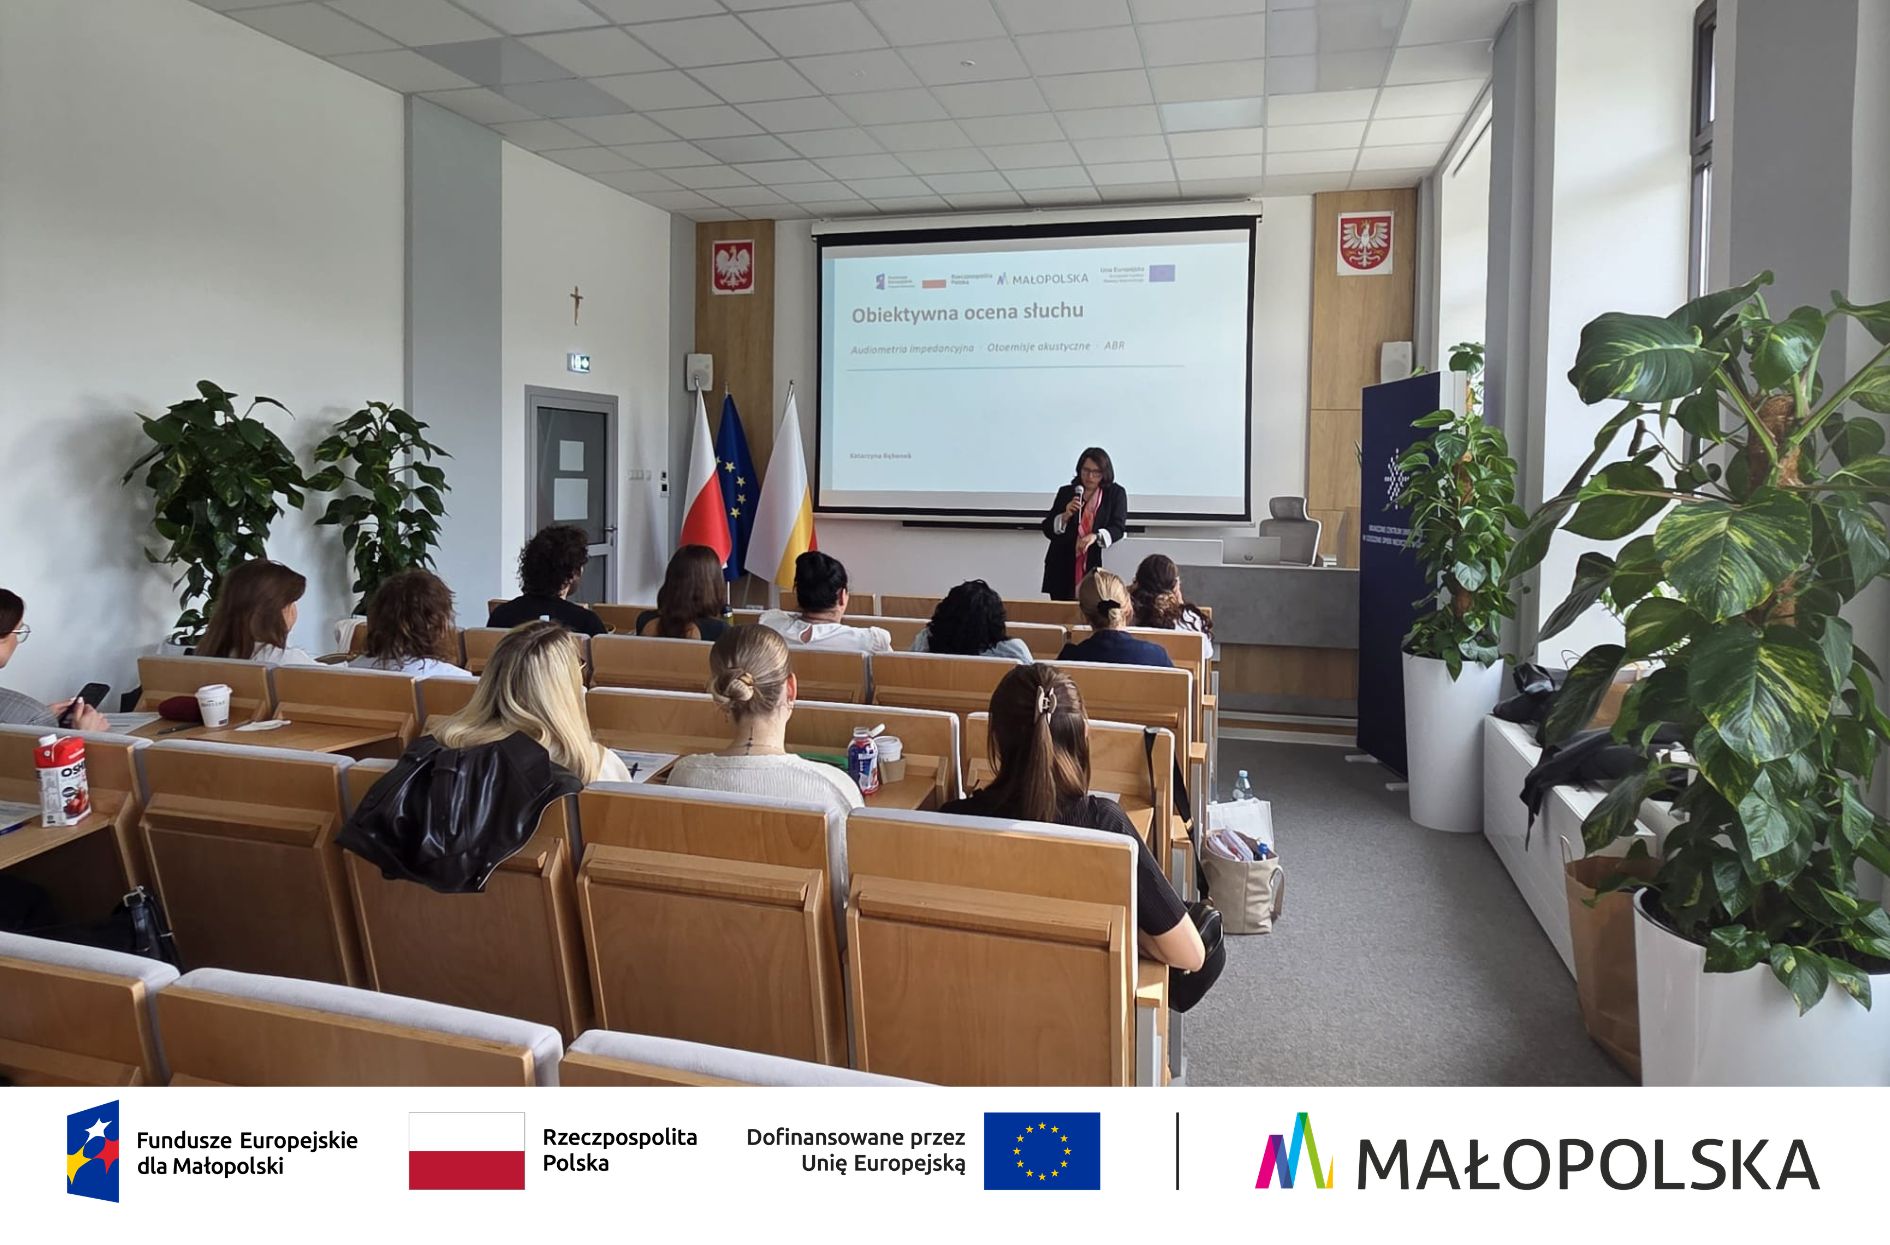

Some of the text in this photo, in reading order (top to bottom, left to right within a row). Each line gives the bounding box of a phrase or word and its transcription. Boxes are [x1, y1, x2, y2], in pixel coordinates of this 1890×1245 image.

[1012, 273, 1089, 285] MAŁOPOLSKA
[851, 301, 1085, 326] Obiektywna ocena słuchu
[850, 340, 1126, 355] Audiometria impedancyjna Otoemisje akustyczne ABR
